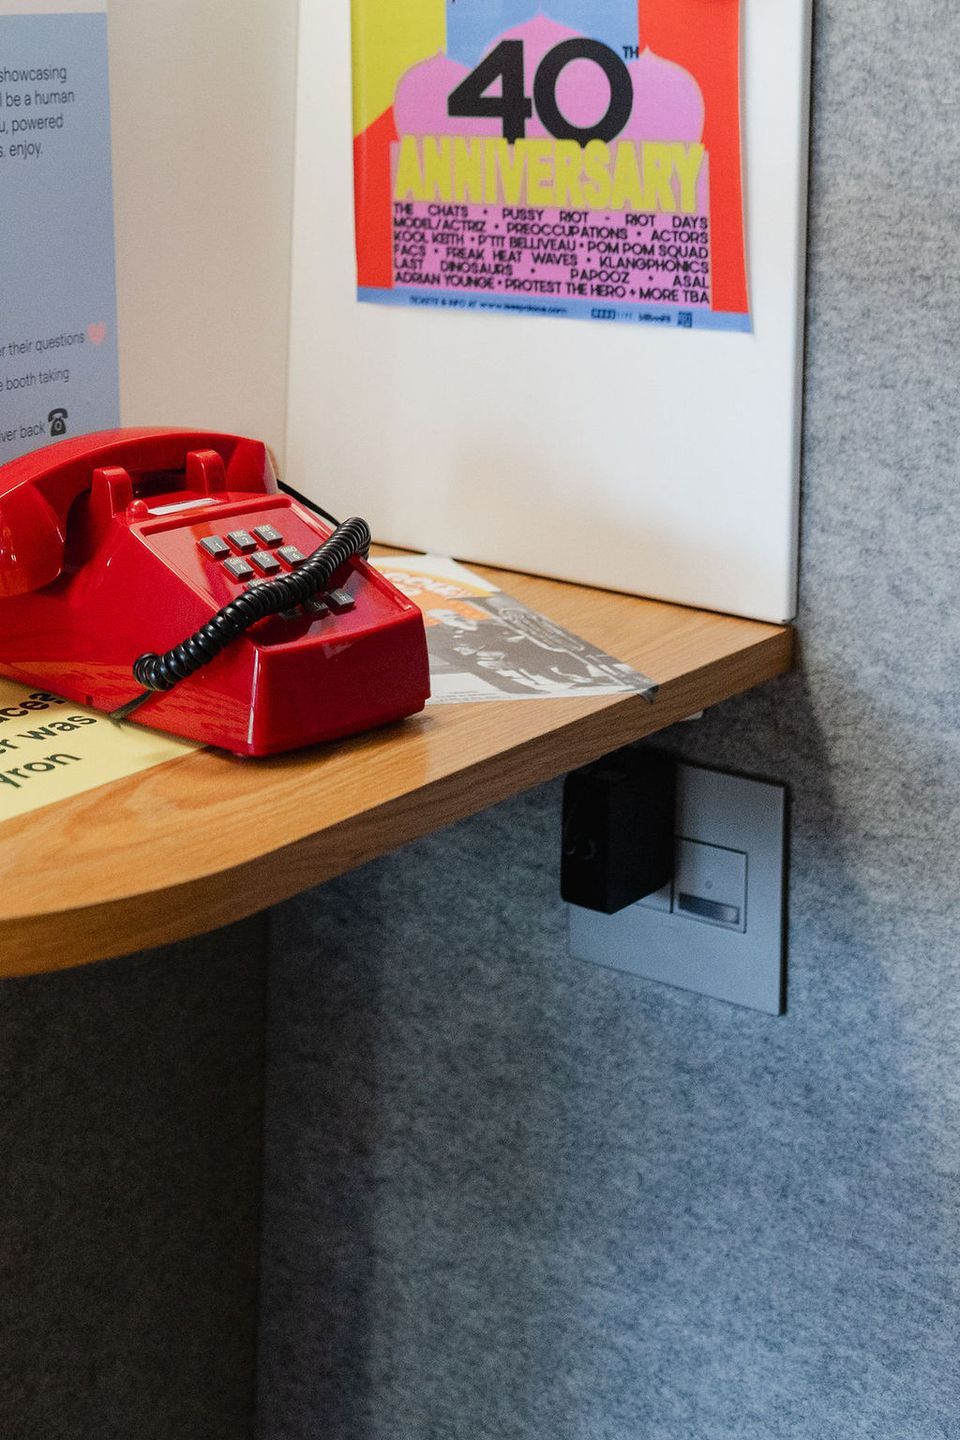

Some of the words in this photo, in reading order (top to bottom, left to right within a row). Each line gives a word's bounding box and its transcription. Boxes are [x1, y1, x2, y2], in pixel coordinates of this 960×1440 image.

[6, 92, 21, 107] be
[35, 90, 75, 105] human
[447, 37, 634, 148] 40
[11, 113, 64, 136] powered
[394, 135, 706, 213] ANNIVERSARY
[394, 203, 413, 215] THE
[428, 204, 468, 218] CHATS
[502, 209, 544, 221] PUSSY
[560, 211, 589, 223] RIOT
[625, 214, 656, 227] RIOT
[672, 216, 708, 229] DAYS
[507, 222, 627, 240] PREOCCUPATIONS
[651, 230, 708, 244] ACTORS
[394, 245, 426, 257] FACS
[447, 248, 484, 260] FREAK
[493, 250, 522, 262] HEAT
[531, 252, 577, 266] WAVES
[599, 256, 709, 274] KLANGPHONICS
[509, 236, 576, 251] BELLIVEAU
[587, 241, 619, 253] POM
[622, 243, 655, 256] POM
[659, 245, 708, 259] SQUAD
[394, 259, 423, 270] LAST
[440, 260, 513, 276] DINOSAURS
[570, 268, 630, 284] PAPOOZ
[673, 275, 709, 289] ASAL
[394, 271, 440, 285] ADRIAN
[444, 275, 494, 289] YOUNGE
[505, 278, 561, 293] PROTEST
[567, 282, 587, 295] THE
[591, 284, 626, 298] HERO
[640, 287, 678, 301] MORE
[683, 290, 709, 304] TBA
[8, 340, 33, 357] their
[35, 332, 86, 352] questions
[5, 374, 37, 392] booth
[38, 368, 70, 384] taking
[20, 421, 46, 439] back
[17, 715, 97, 742] was
